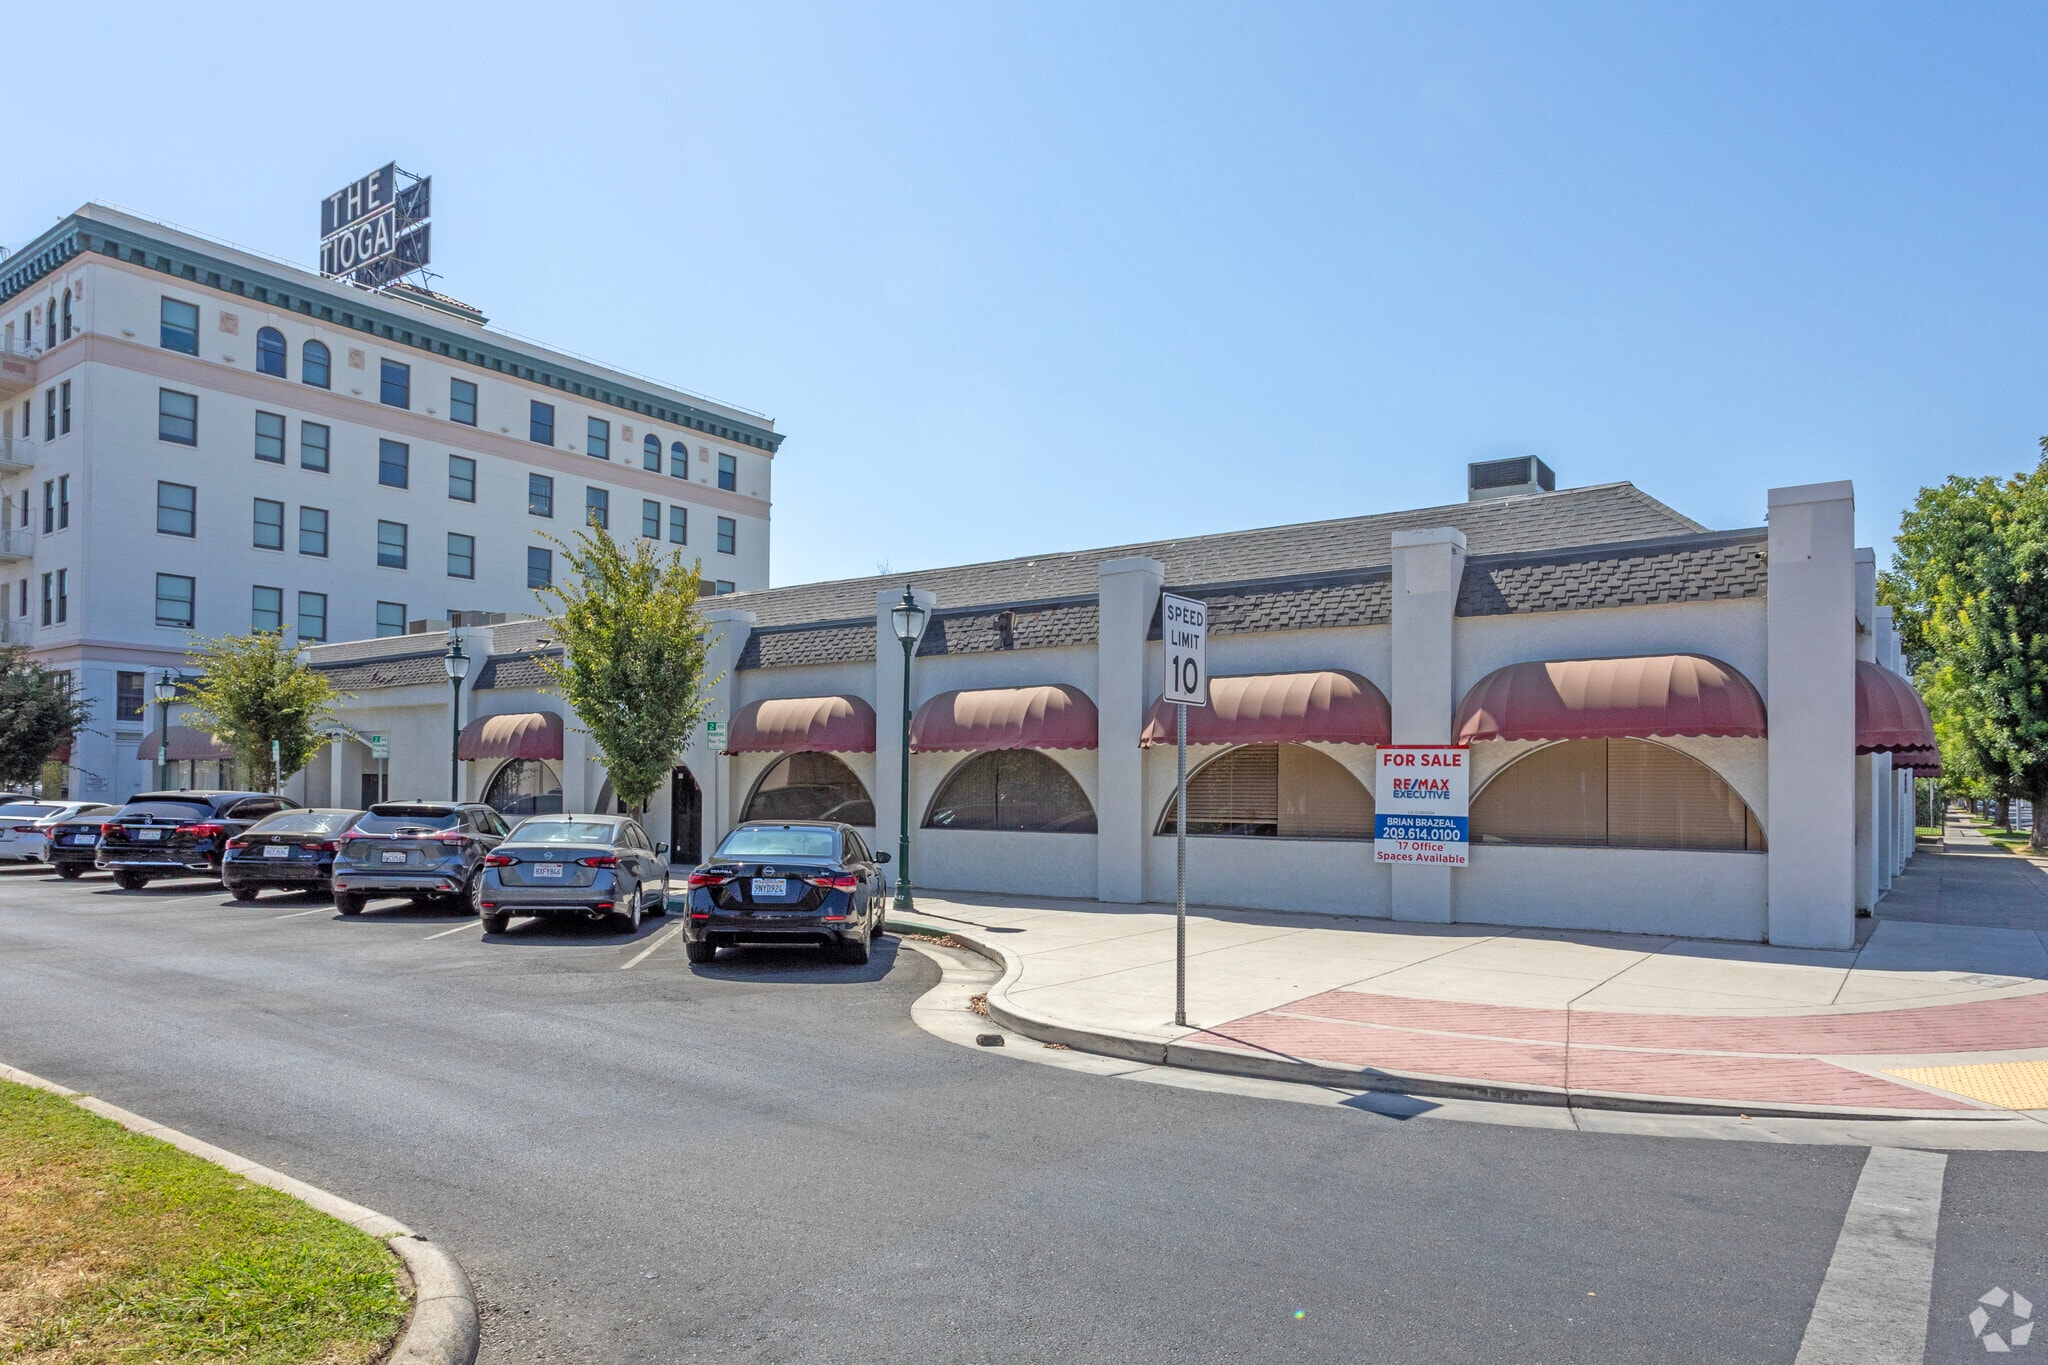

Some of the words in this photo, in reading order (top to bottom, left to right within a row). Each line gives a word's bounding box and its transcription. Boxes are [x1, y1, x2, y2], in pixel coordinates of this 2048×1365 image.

[330, 170, 380, 228] THE
[320, 215, 389, 277] TIOGA
[1167, 604, 1204, 627] SPEED
[1171, 629, 1200, 650] LIMIT
[1172, 655, 1198, 694] 10
[1383, 753, 1415, 767] FOR
[1421, 753, 1462, 767] SALE
[1393, 778, 1449, 790] RE/MAX
[1393, 790, 1450, 799] EXECUTIVE
[1387, 817, 1414, 827] BRIAN
[1415, 819, 1456, 828] BRAZEAL
[1382, 827, 1461, 841] 209.614.0100
[1398, 841, 1408, 850] 17
[1411, 842, 1444, 851] Office
[1377, 851, 1413, 861] Spaces
[1416, 853, 1466, 863] Available
